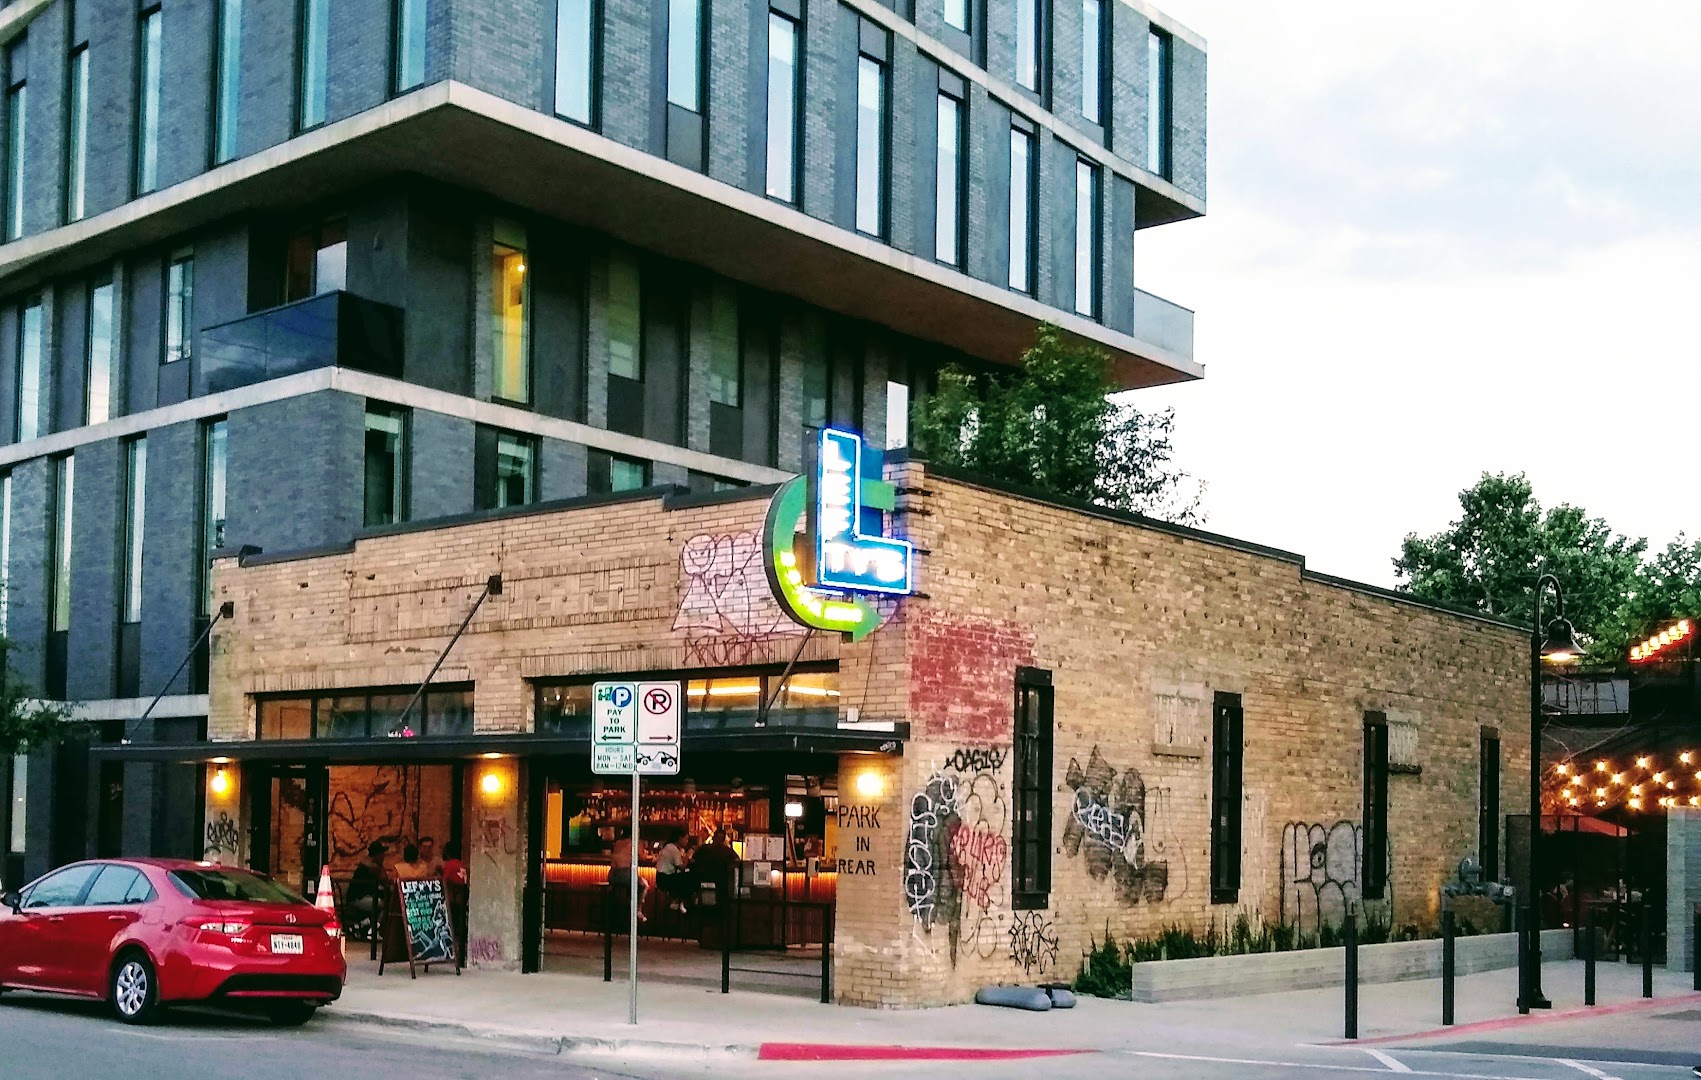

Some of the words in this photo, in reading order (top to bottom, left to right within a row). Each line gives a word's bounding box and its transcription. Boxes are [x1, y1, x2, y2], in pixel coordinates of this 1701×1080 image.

[838, 805, 880, 829] PARK
[856, 836, 870, 852] IN
[838, 859, 876, 876] REAR
